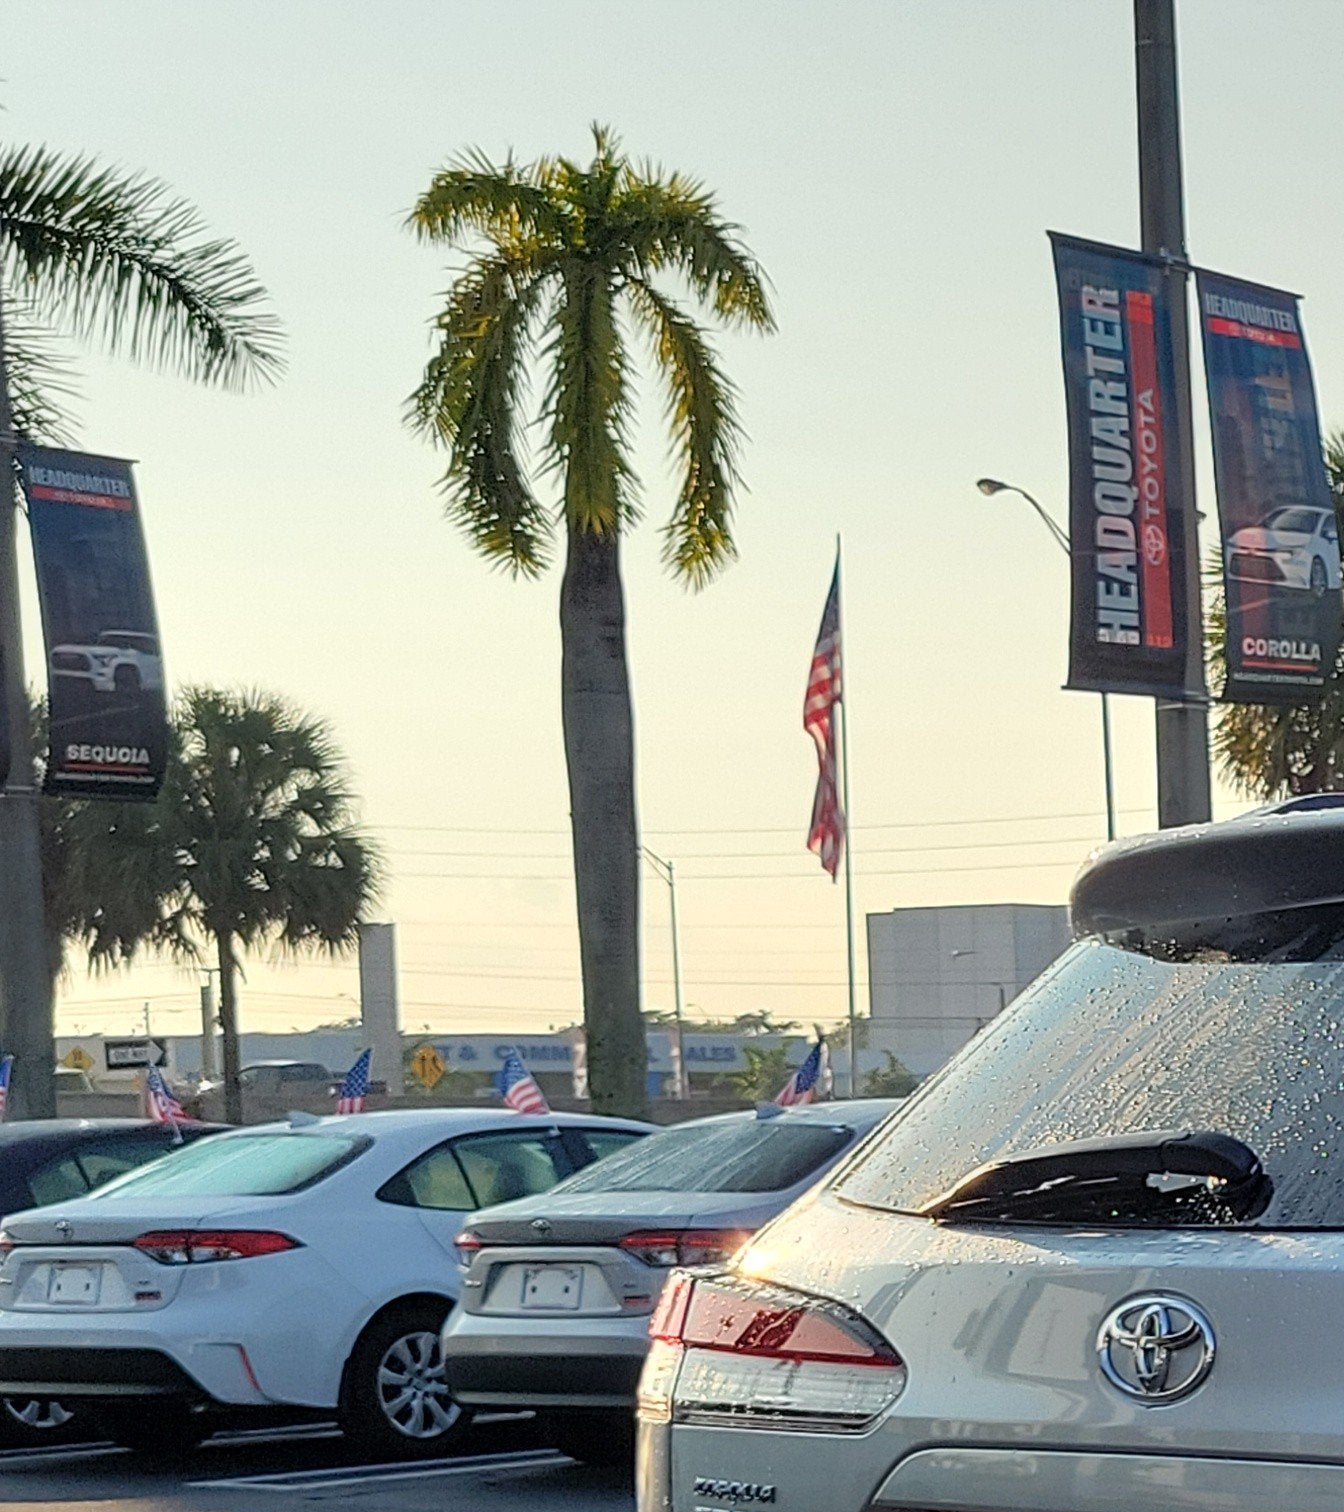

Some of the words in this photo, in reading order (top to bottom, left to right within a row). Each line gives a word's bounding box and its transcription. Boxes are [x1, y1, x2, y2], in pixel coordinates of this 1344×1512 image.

[1205, 292, 1297, 332] HEADQUARTER
[1081, 284, 1140, 646] HEADQUARTER
[1138, 389, 1167, 520] TOYOTA
[29, 465, 131, 498] HEADQUARTER
[1242, 637, 1321, 660] COROLLA
[67, 744, 150, 764] SEQUOIA
